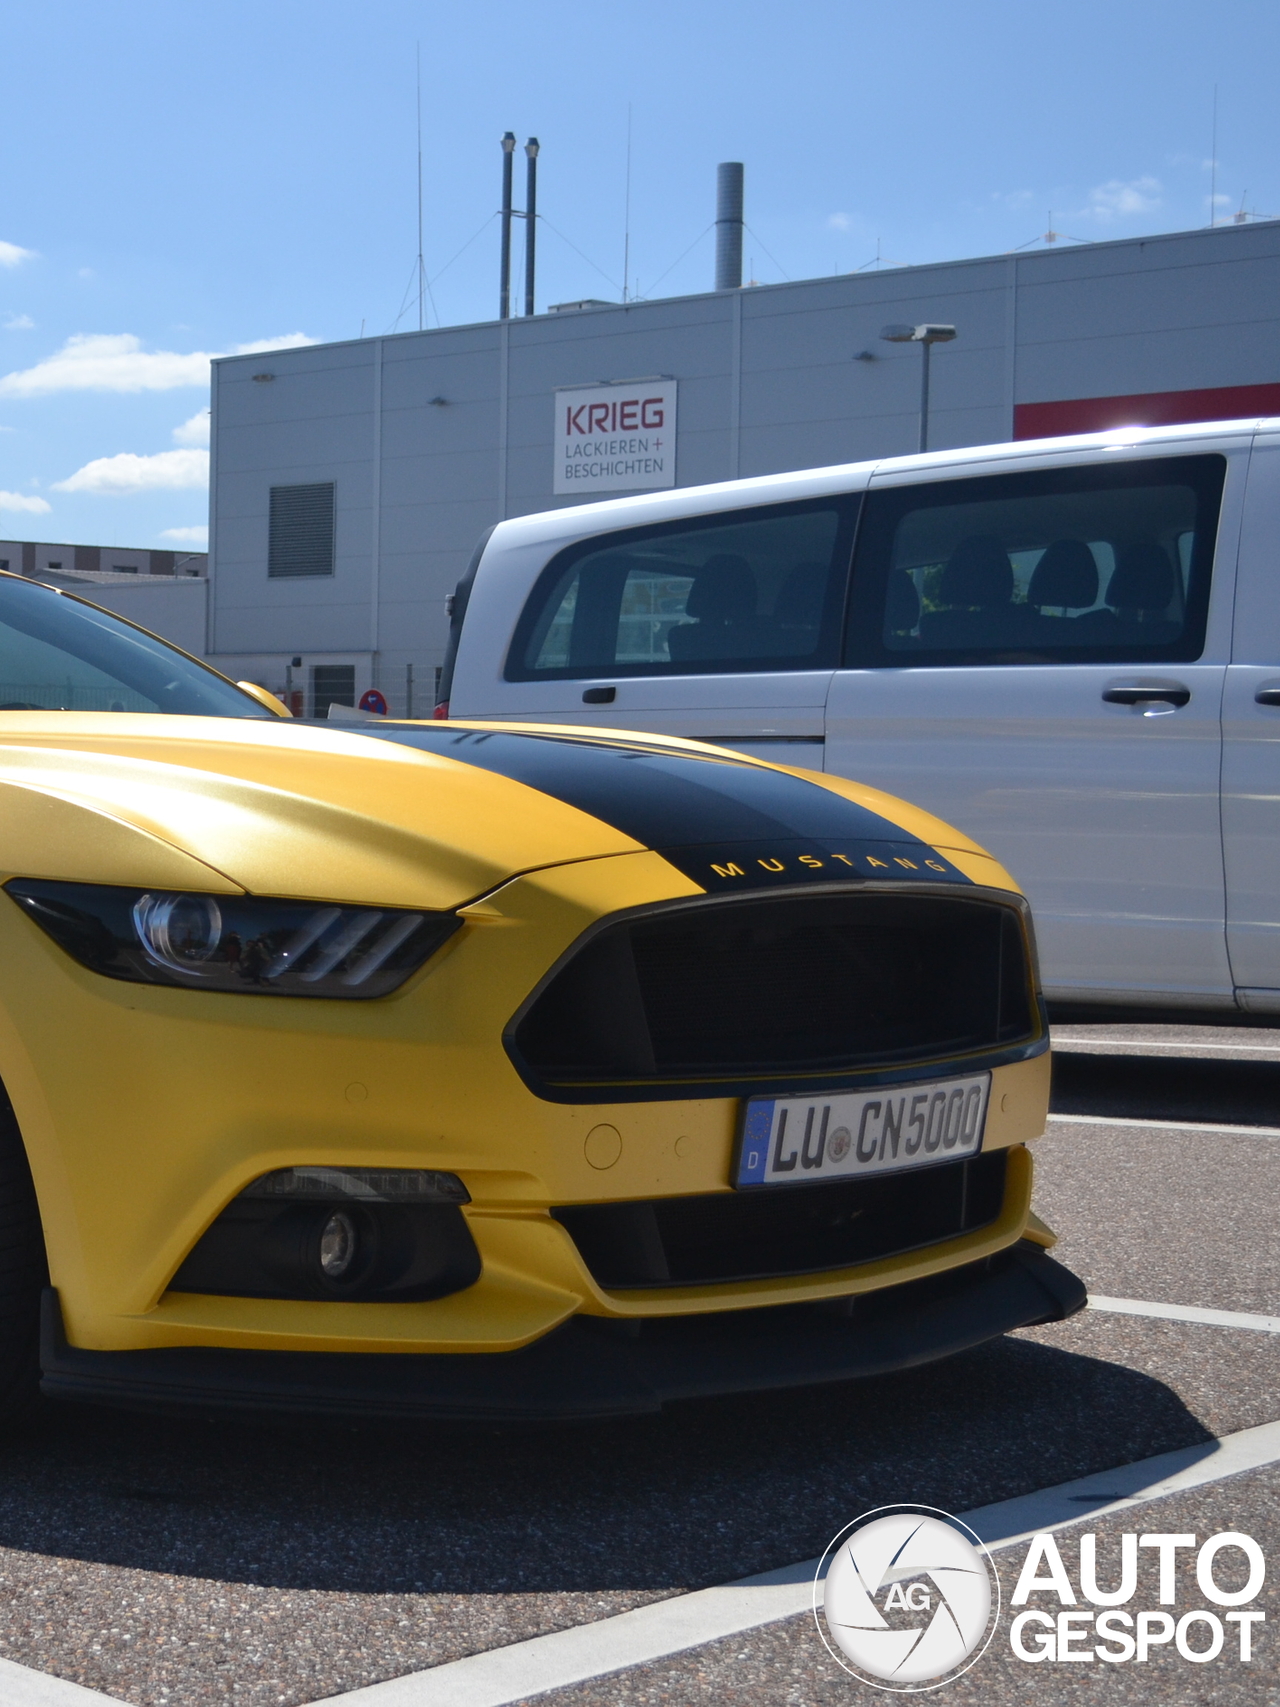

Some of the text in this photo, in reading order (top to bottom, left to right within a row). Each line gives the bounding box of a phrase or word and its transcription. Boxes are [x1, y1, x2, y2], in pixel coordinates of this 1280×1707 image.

[566, 397, 664, 436] KRIEG
[565, 438, 649, 459] LACKIEREN
[565, 458, 664, 479] BESCHICHTEN
[710, 854, 947, 878] MUSTANG
[772, 1105, 831, 1172] LU
[747, 1151, 759, 1170] D
